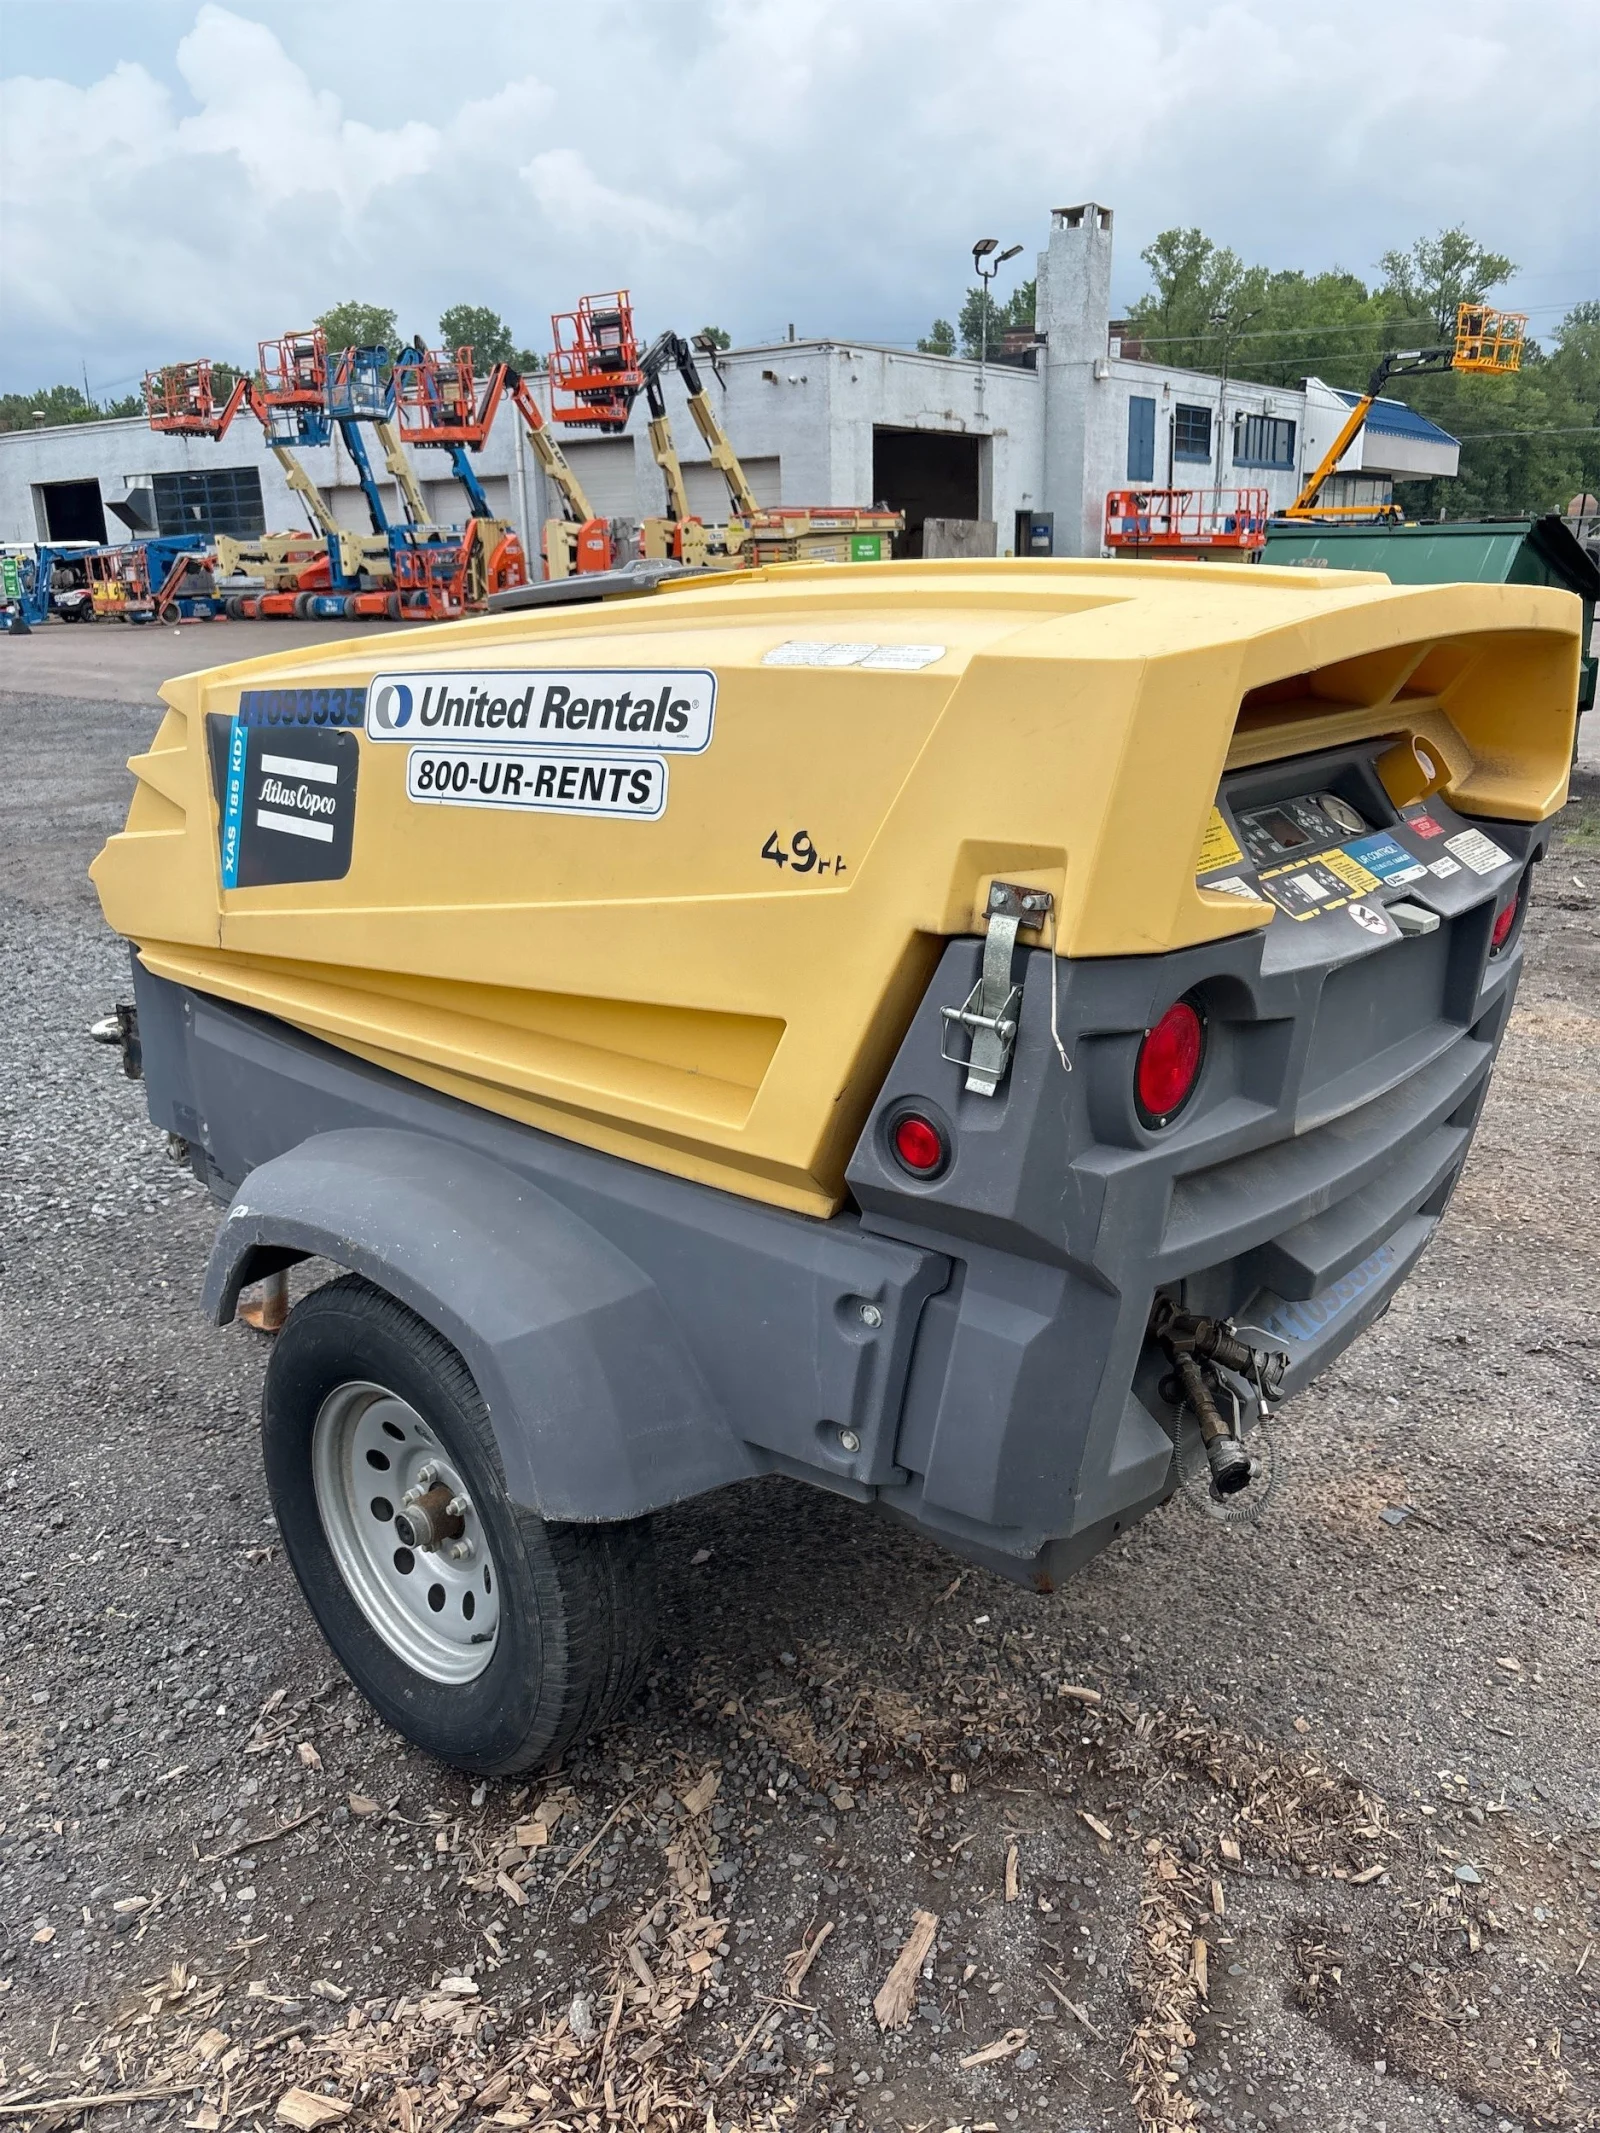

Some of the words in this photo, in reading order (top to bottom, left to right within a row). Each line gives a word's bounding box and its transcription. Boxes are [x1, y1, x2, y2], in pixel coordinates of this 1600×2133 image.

[420, 685, 535, 730] United
[232, 727, 243, 772] KD7
[230, 780, 239, 817] 185
[259, 778, 297, 808] Atlas
[297, 785, 336, 816] Copco
[417, 759, 653, 805] 800-UR-RENTS
[225, 827, 237, 873] XAS
[1368, 843, 1398, 861] CONTROL
